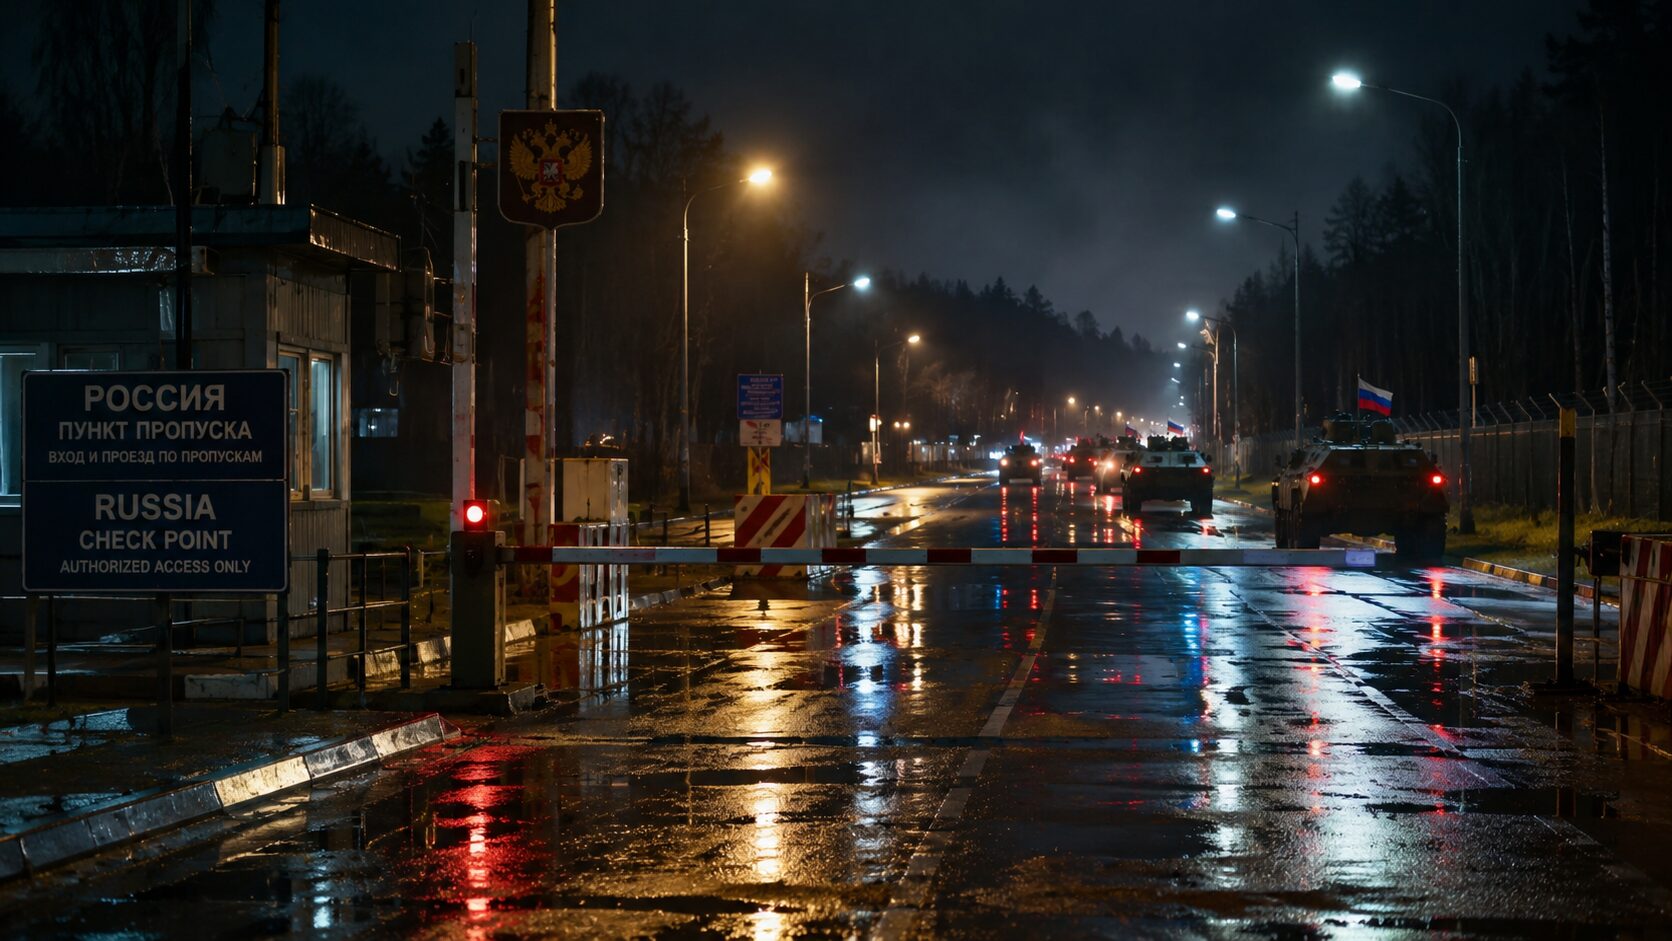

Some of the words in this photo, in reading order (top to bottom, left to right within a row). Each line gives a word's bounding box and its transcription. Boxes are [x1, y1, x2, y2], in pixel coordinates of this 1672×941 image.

[85, 384, 224, 411] РОССИЯ
[59, 422, 128, 439] ПУНКТ
[137, 421, 252, 439] ПРОПУСКА
[49, 451, 84, 464] ВХОД
[89, 451, 98, 463] И
[103, 451, 154, 464] ПРОЕЗД
[159, 451, 177, 462] ПО
[182, 451, 262, 462] ПРОПУСКАМ
[96, 494, 216, 520] RUSSIA
[79, 531, 156, 549] CHECK
[165, 531, 232, 549] POINT
[61, 560, 150, 573] AUTHORIZED
[155, 560, 209, 573] ACCESS
[215, 560, 250, 572] ONLY
